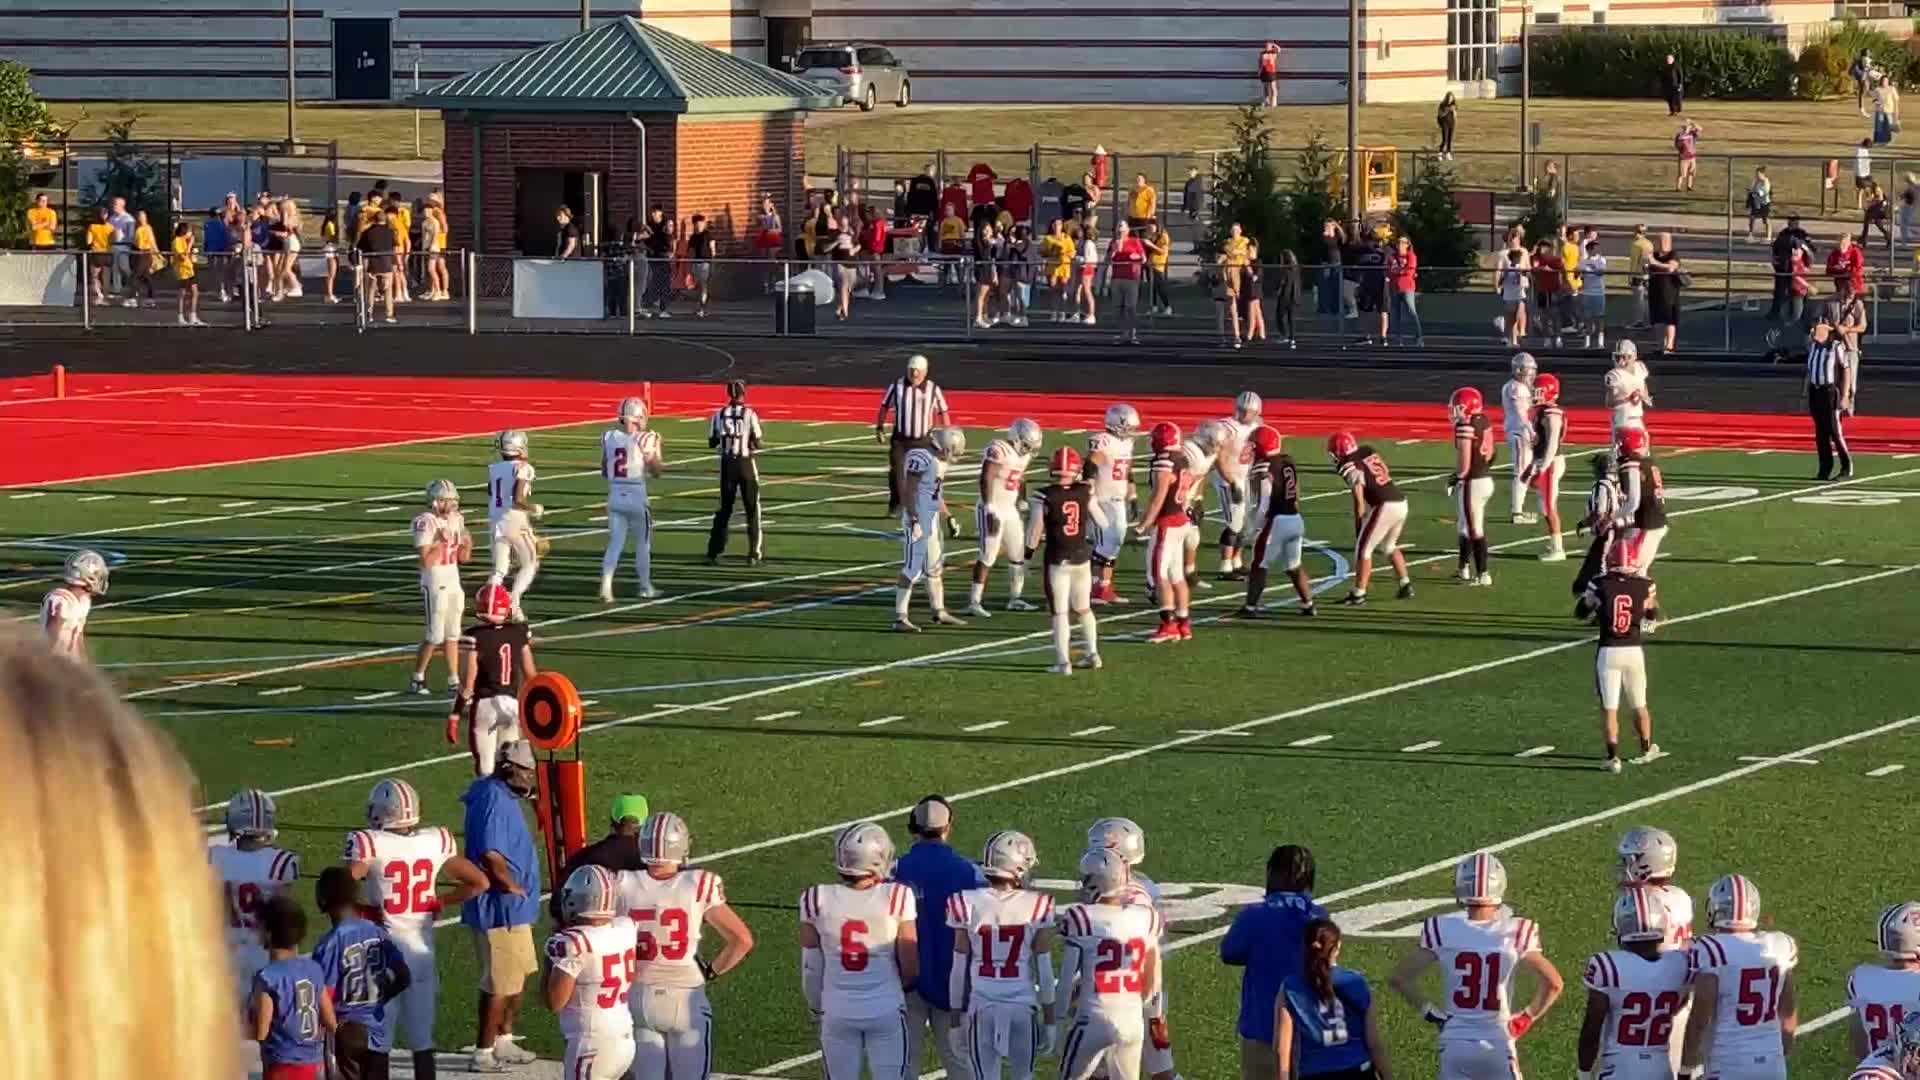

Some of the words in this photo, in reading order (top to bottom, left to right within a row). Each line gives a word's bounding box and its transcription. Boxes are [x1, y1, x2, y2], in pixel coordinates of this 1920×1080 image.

[614, 446, 627, 478] 2
[1061, 500, 1080, 536] 3
[1612, 594, 1632, 633] 6
[498, 642, 511, 685] 1
[382, 859, 435, 914] 32
[840, 919, 869, 970] 6
[977, 924, 1024, 977] 17
[1095, 937, 1146, 993] 23
[1452, 951, 1500, 1010] 31
[1735, 965, 1779, 1026] 51
[295, 978, 318, 1040] 8
[1617, 990, 1679, 1046] 22
